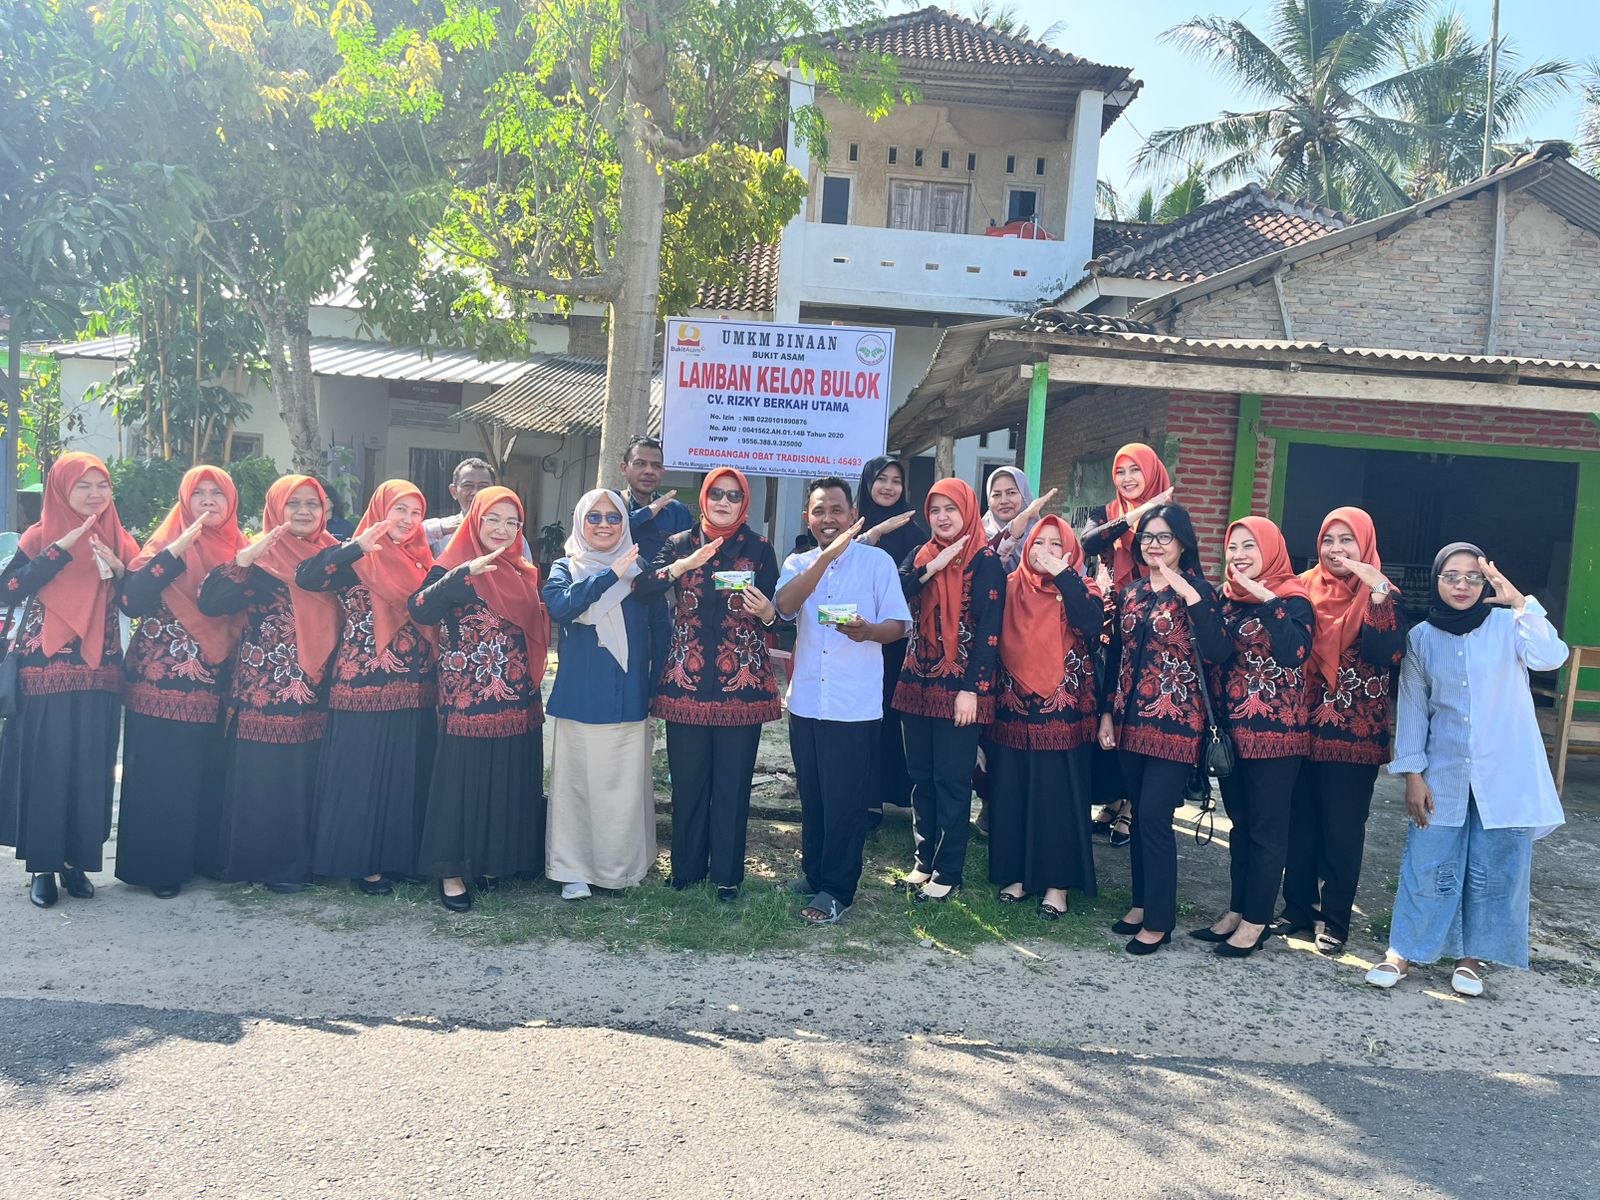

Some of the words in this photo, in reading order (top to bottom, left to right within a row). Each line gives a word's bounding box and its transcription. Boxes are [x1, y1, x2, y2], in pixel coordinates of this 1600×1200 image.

[722, 330, 771, 347] UMKM
[776, 333, 838, 351] BINAAN
[752, 351, 779, 360] BUKIT
[780, 352, 805, 361] ASAM
[679, 361, 752, 392] LAMBAN
[756, 365, 815, 396] KELOR
[820, 369, 881, 400] BULOK
[707, 394, 724, 405] CV.
[727, 395, 761, 408] RIZKY
[763, 397, 809, 410] BERKAH
[811, 401, 850, 413] UTAMA
[709, 413, 721, 421] No.
[709, 424, 720, 432] No.
[721, 425, 737, 433] AHU
[806, 431, 827, 439] Tahun
[688, 448, 750, 459] PERDAGANGAN
[752, 451, 774, 461] OBAT
[776, 453, 831, 464] TRADISIONAL
[837, 457, 862, 467] 46493
